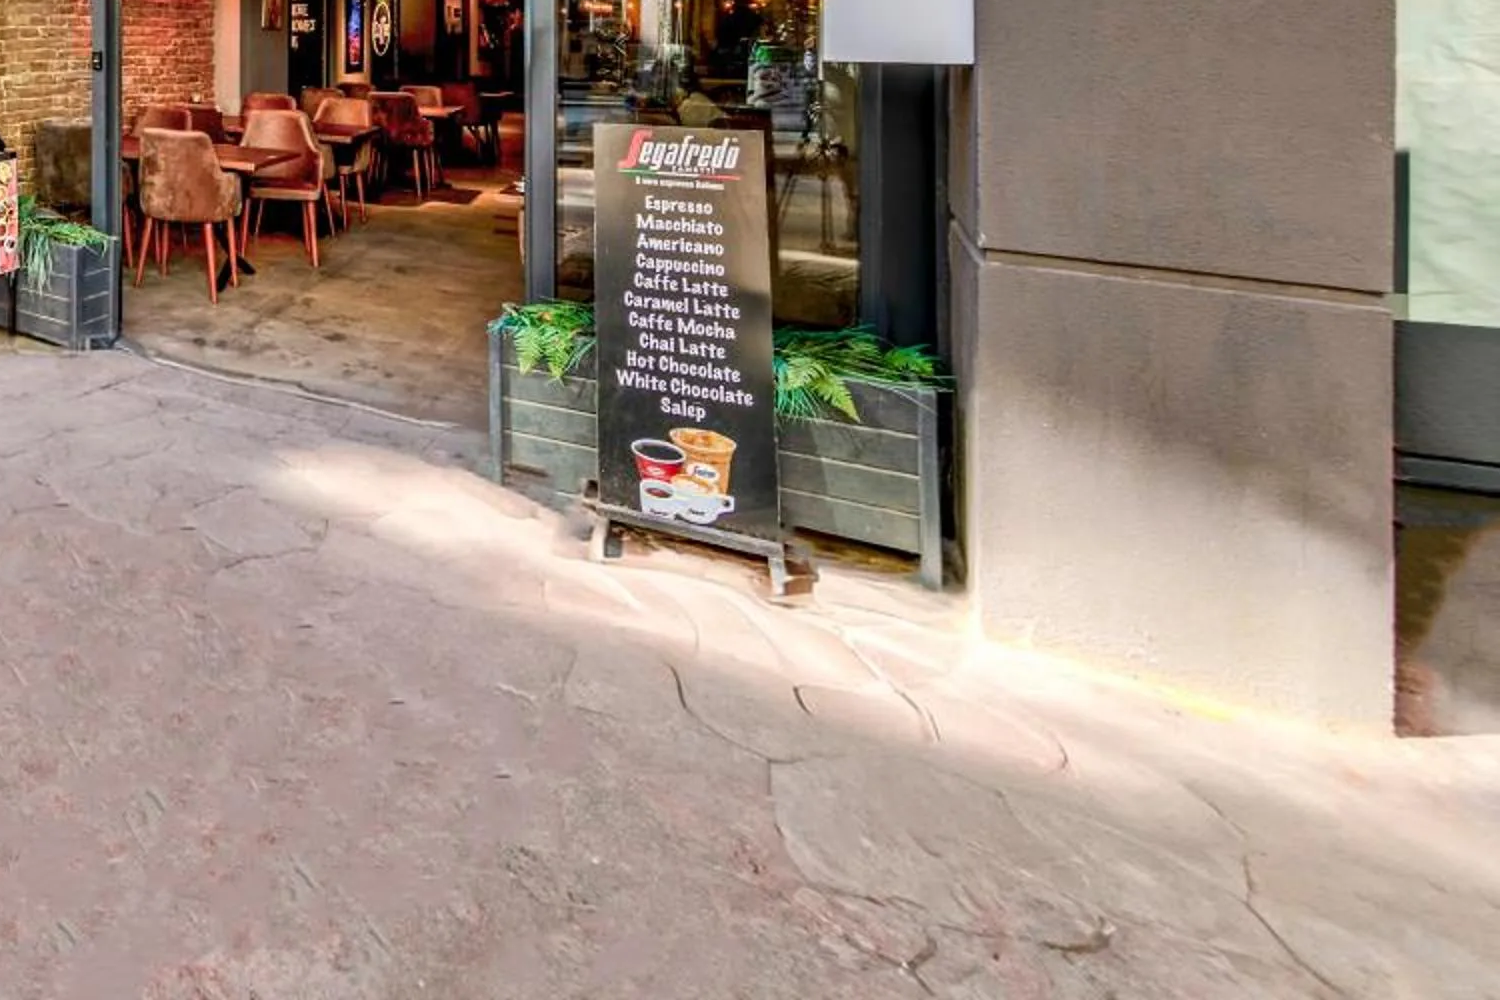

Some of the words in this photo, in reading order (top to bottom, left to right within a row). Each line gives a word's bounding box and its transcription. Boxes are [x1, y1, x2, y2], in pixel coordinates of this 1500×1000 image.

[617, 129, 741, 171] Segafredo
[645, 195, 713, 215] Espresso
[636, 214, 723, 236] Macchiato
[636, 234, 724, 257] Americano
[636, 253, 725, 276] Cappuccino
[634, 272, 678, 292] Caffe
[682, 277, 729, 297] Latte
[624, 291, 689, 313] Caramel
[694, 298, 741, 319] Latte
[629, 311, 673, 332] Caffe
[677, 318, 736, 340] Mocha
[639, 332, 675, 353] Chai
[679, 339, 726, 360] Latte
[627, 350, 655, 369] Hot
[659, 355, 741, 383] Chocolate
[616, 369, 667, 394] White
[671, 378, 754, 406] Chocolate
[660, 397, 706, 422] Salep
